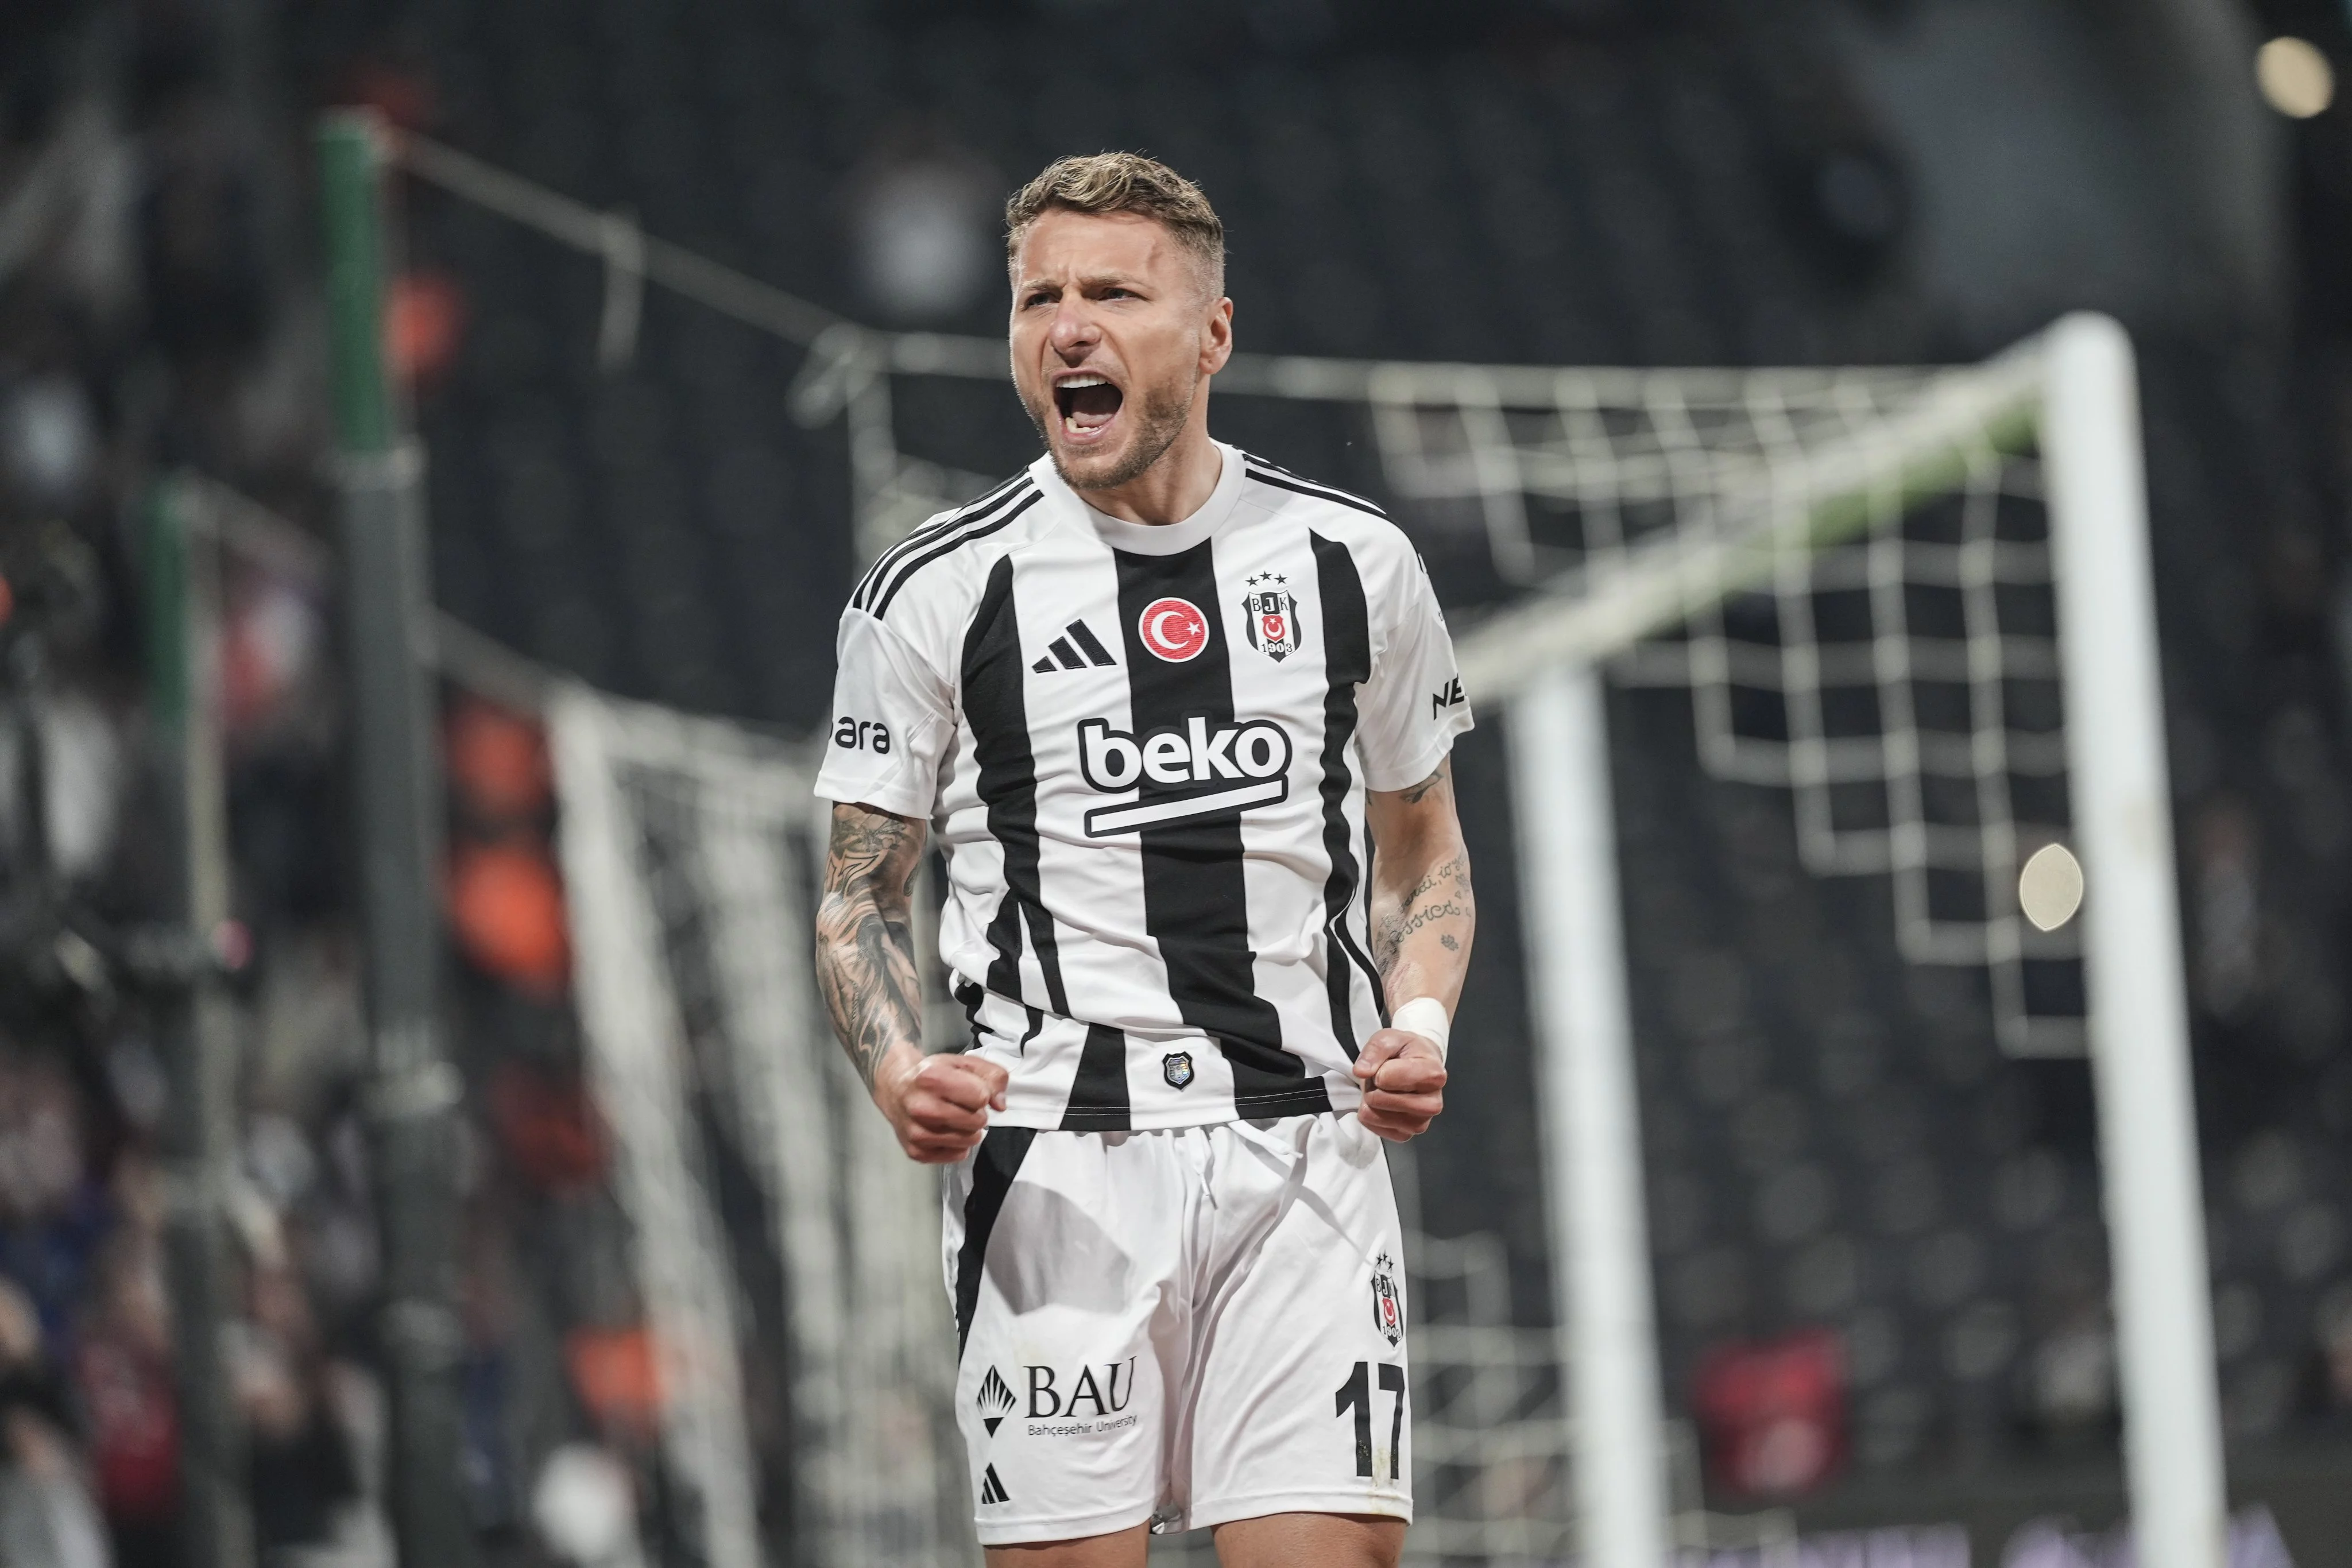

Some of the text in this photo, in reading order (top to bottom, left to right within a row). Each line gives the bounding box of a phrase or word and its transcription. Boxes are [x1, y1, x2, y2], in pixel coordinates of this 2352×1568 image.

[1252, 597, 1289, 612] BJK
[1261, 642, 1293, 653] 1903
[1433, 672, 1467, 721] NE
[829, 717, 890, 754] ara
[1083, 716, 1286, 789] beko
[1023, 1356, 1137, 1419] BAU
[1028, 1415, 1138, 1437] Bahçeşehir University
[1335, 1361, 1405, 1480] 17
